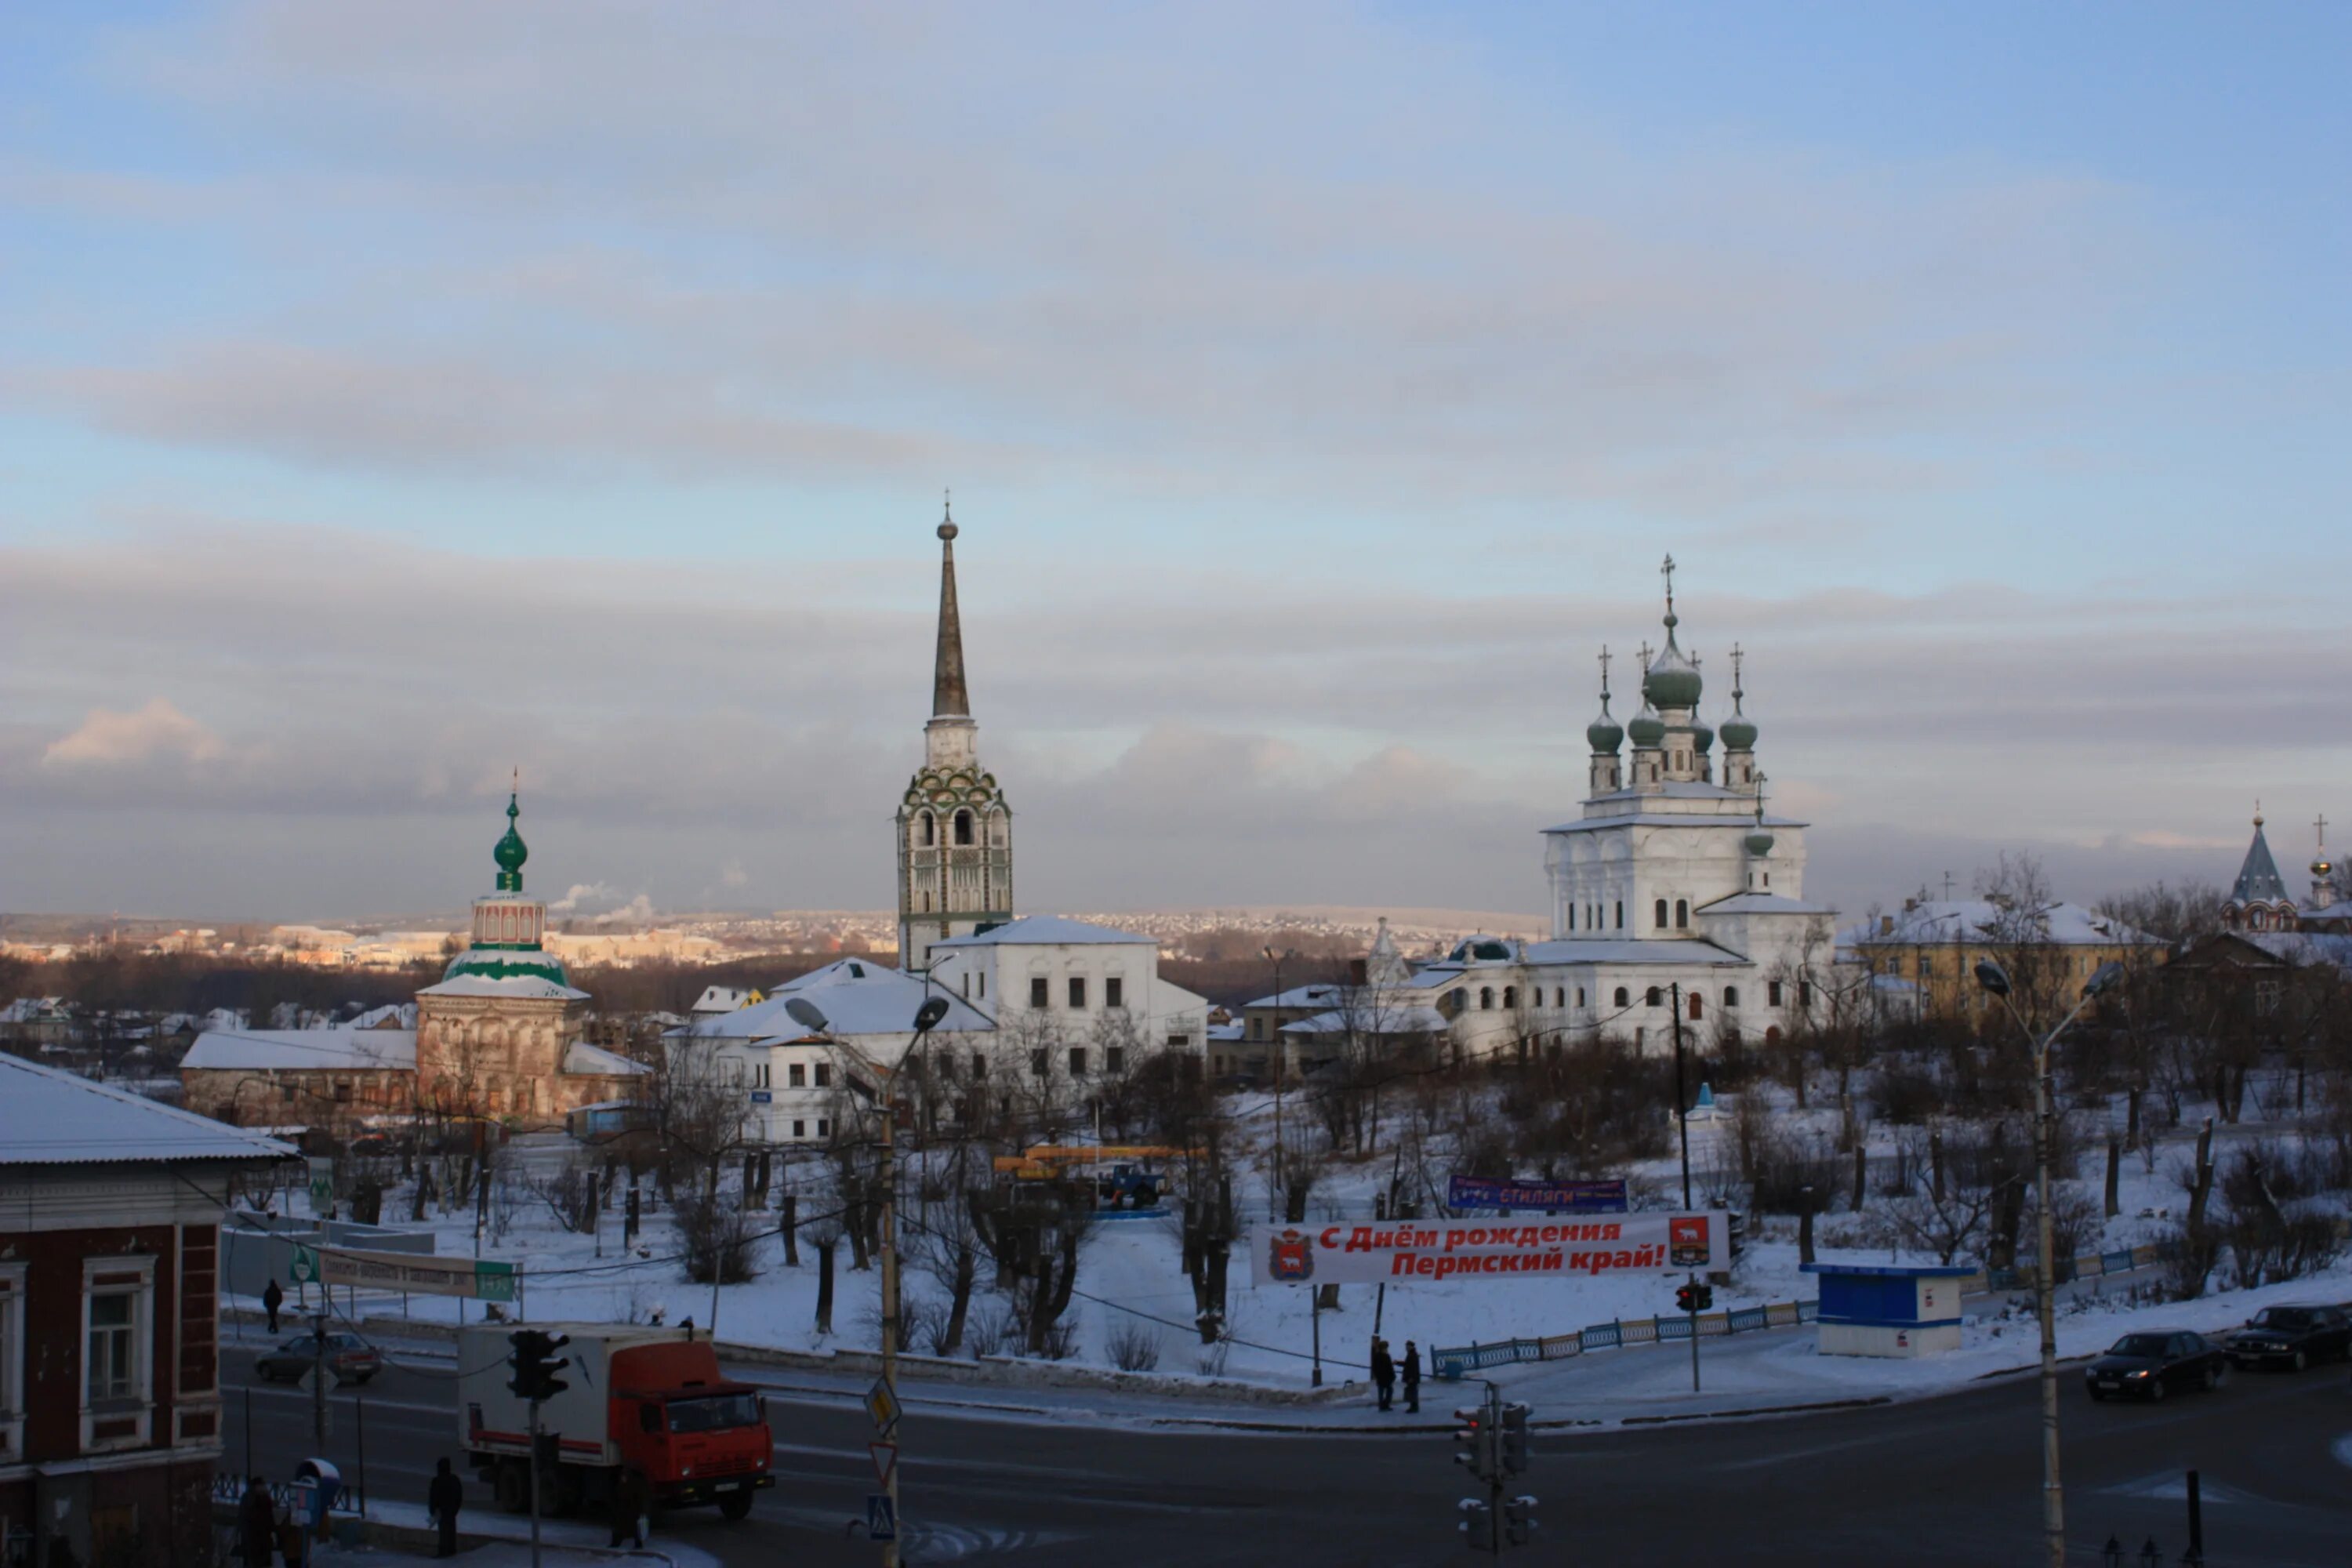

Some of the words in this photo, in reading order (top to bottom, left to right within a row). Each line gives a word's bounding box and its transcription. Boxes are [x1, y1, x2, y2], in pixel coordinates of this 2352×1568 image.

[1500, 1188, 1573, 1204] СТИЛЯГИ
[1320, 1228, 1340, 1248] С
[1346, 1225, 1437, 1252] Днём
[1446, 1224, 1621, 1251] рождения
[1392, 1247, 1562, 1279] Пермский
[1570, 1244, 1665, 1275] край!
